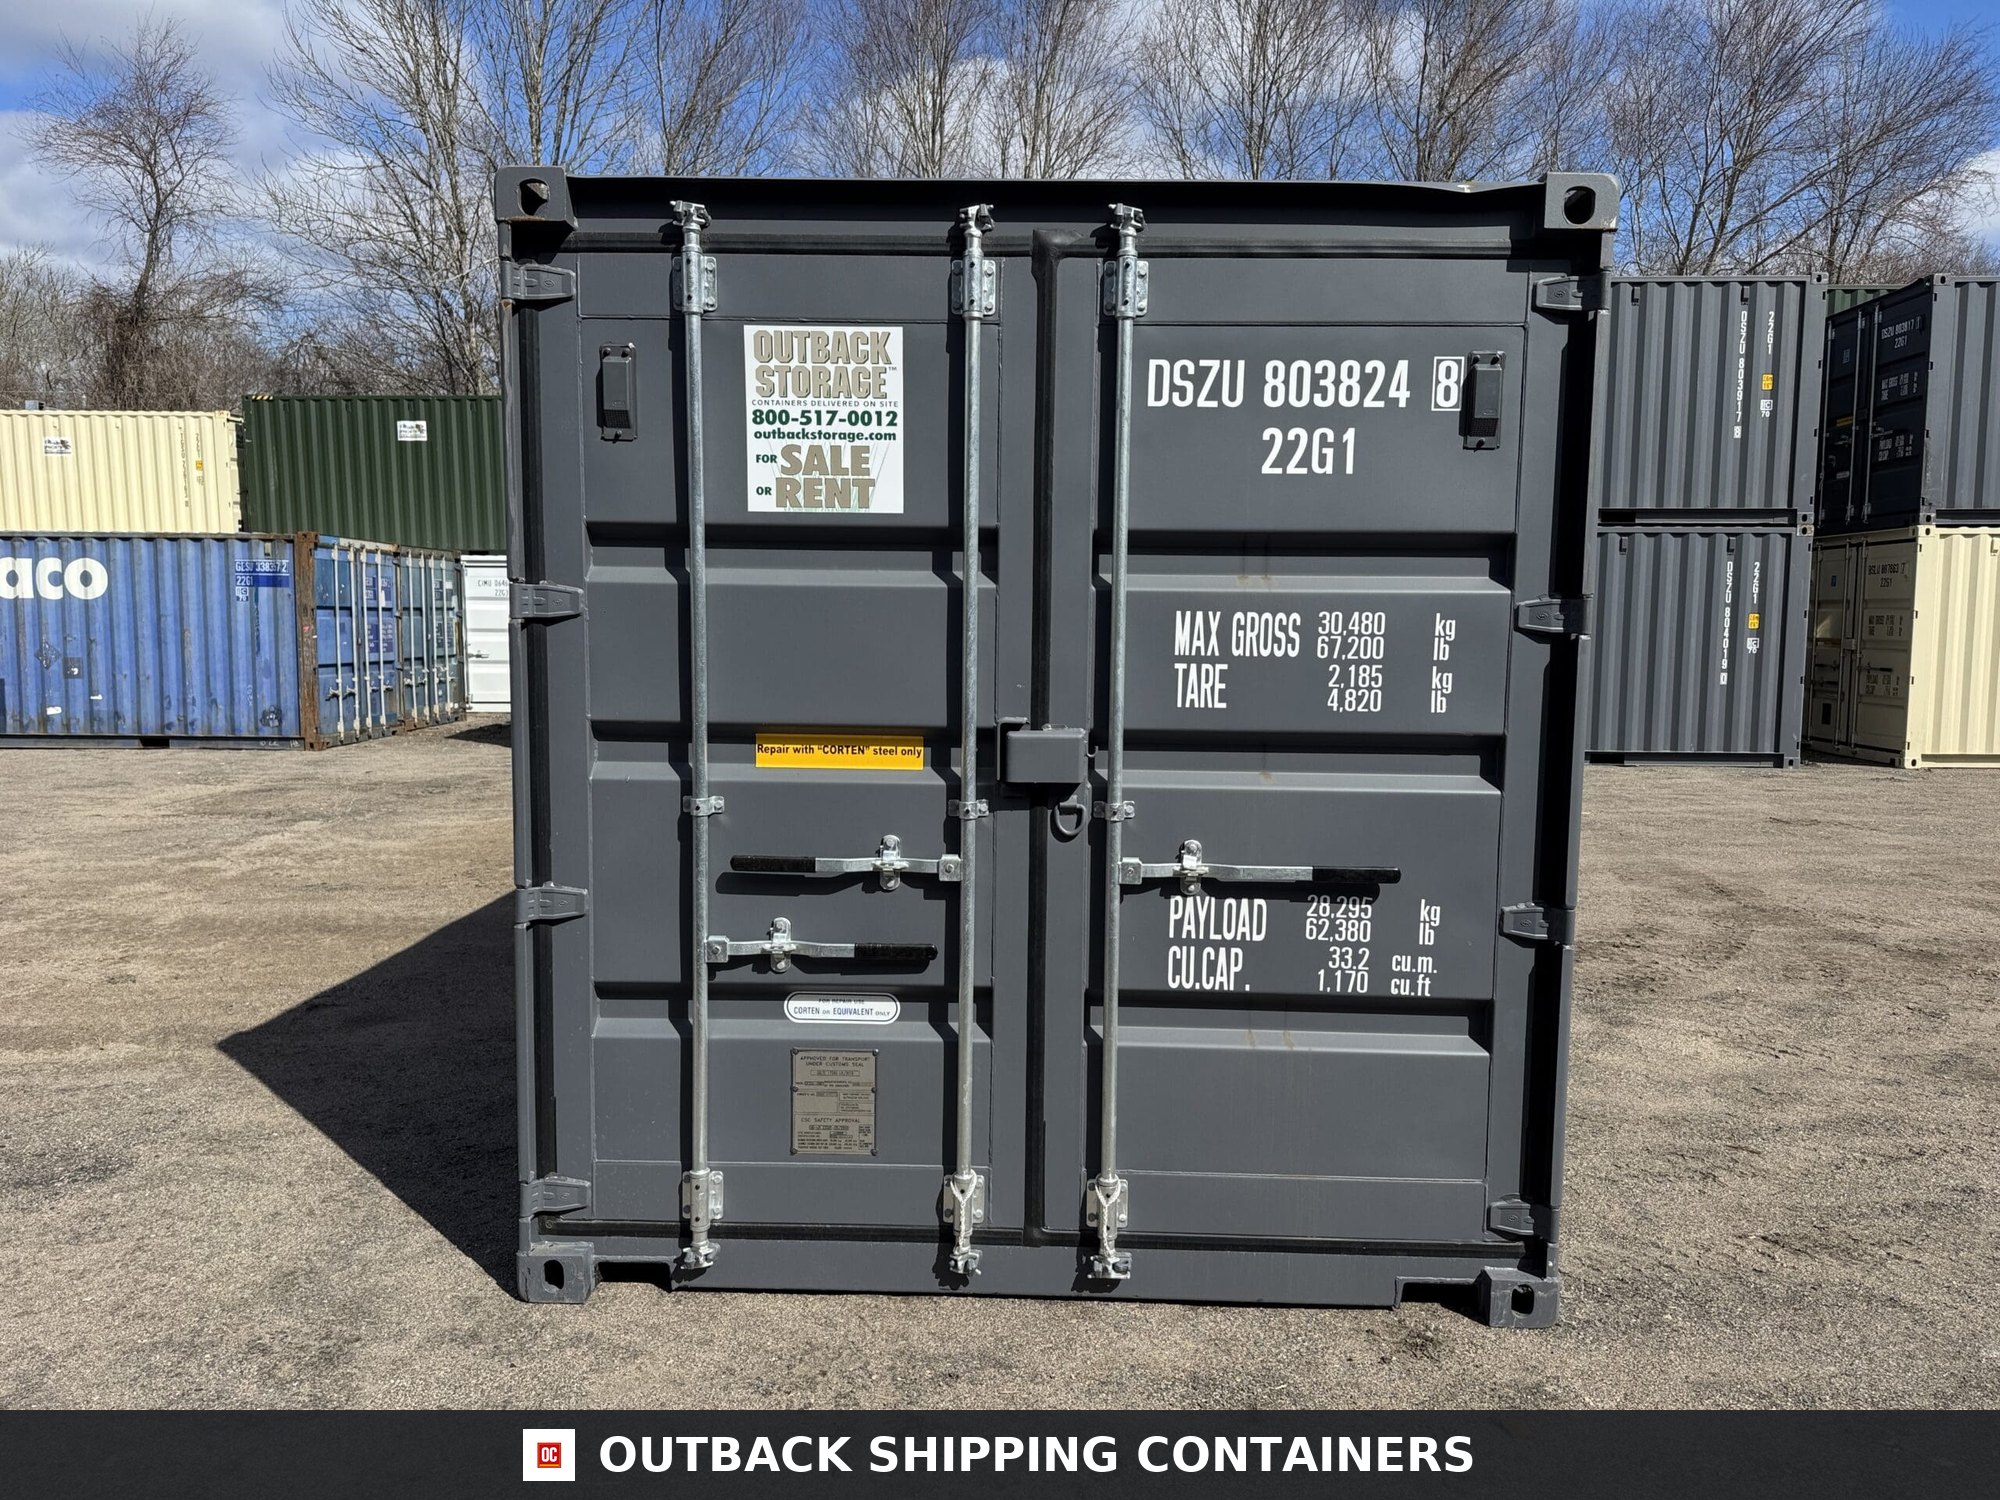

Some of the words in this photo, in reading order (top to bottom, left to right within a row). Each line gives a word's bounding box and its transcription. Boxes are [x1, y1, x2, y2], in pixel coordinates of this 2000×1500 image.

[753, 330, 892, 364] OUTBACK
[1739, 311, 1747, 354] DSZU
[755, 365, 887, 399] STORAGE
[1147, 359, 1245, 407] DSZU
[1263, 359, 1410, 408] 803824
[1436, 360, 1459, 408] 8
[1736, 358, 1745, 422] 803917
[752, 409, 898, 426] 800-517-0012
[754, 428, 896, 442] outbackstorage.com
[1261, 427, 1356, 475] 22G1
[756, 454, 777, 463] FOR
[780, 444, 870, 476] SALE
[756, 487, 772, 496] OR
[775, 477, 875, 509] RENT
[236, 576, 254, 586] 22G1
[1725, 561, 1733, 603] DSZU
[1174, 611, 1221, 656] MAX
[1231, 612, 1301, 657] GROSS
[1318, 611, 1386, 636] 30,480
[1434, 613, 1456, 641] kg
[1316, 636, 1384, 661] 67,200
[1433, 637, 1449, 661] lb
[1721, 607, 1730, 669] 804019
[1174, 663, 1228, 709] TARE
[1328, 664, 1383, 689] 2,185
[1431, 666, 1453, 694] kg
[1327, 689, 1382, 713] 4,820
[1430, 690, 1447, 713] lb
[757, 743, 790, 755] Repair
[792, 744, 815, 754] with
[873, 745, 898, 756] steel
[900, 746, 922, 758] only
[1168, 895, 1267, 942] PAYLOAD
[1306, 895, 1372, 919] 28,295
[1419, 899, 1441, 927] kg
[1305, 918, 1372, 943] 62,380
[1419, 923, 1435, 945] lb
[1167, 946, 1250, 991] CU.CAP.
[1328, 947, 1370, 970] 33.2
[1391, 955, 1438, 974] cu.m.
[1317, 969, 1368, 994] 1,170
[1390, 975, 1431, 997] cu.ft
[793, 1007, 820, 1015] CORTEN
[833, 1007, 874, 1016] EQUIVALENT
